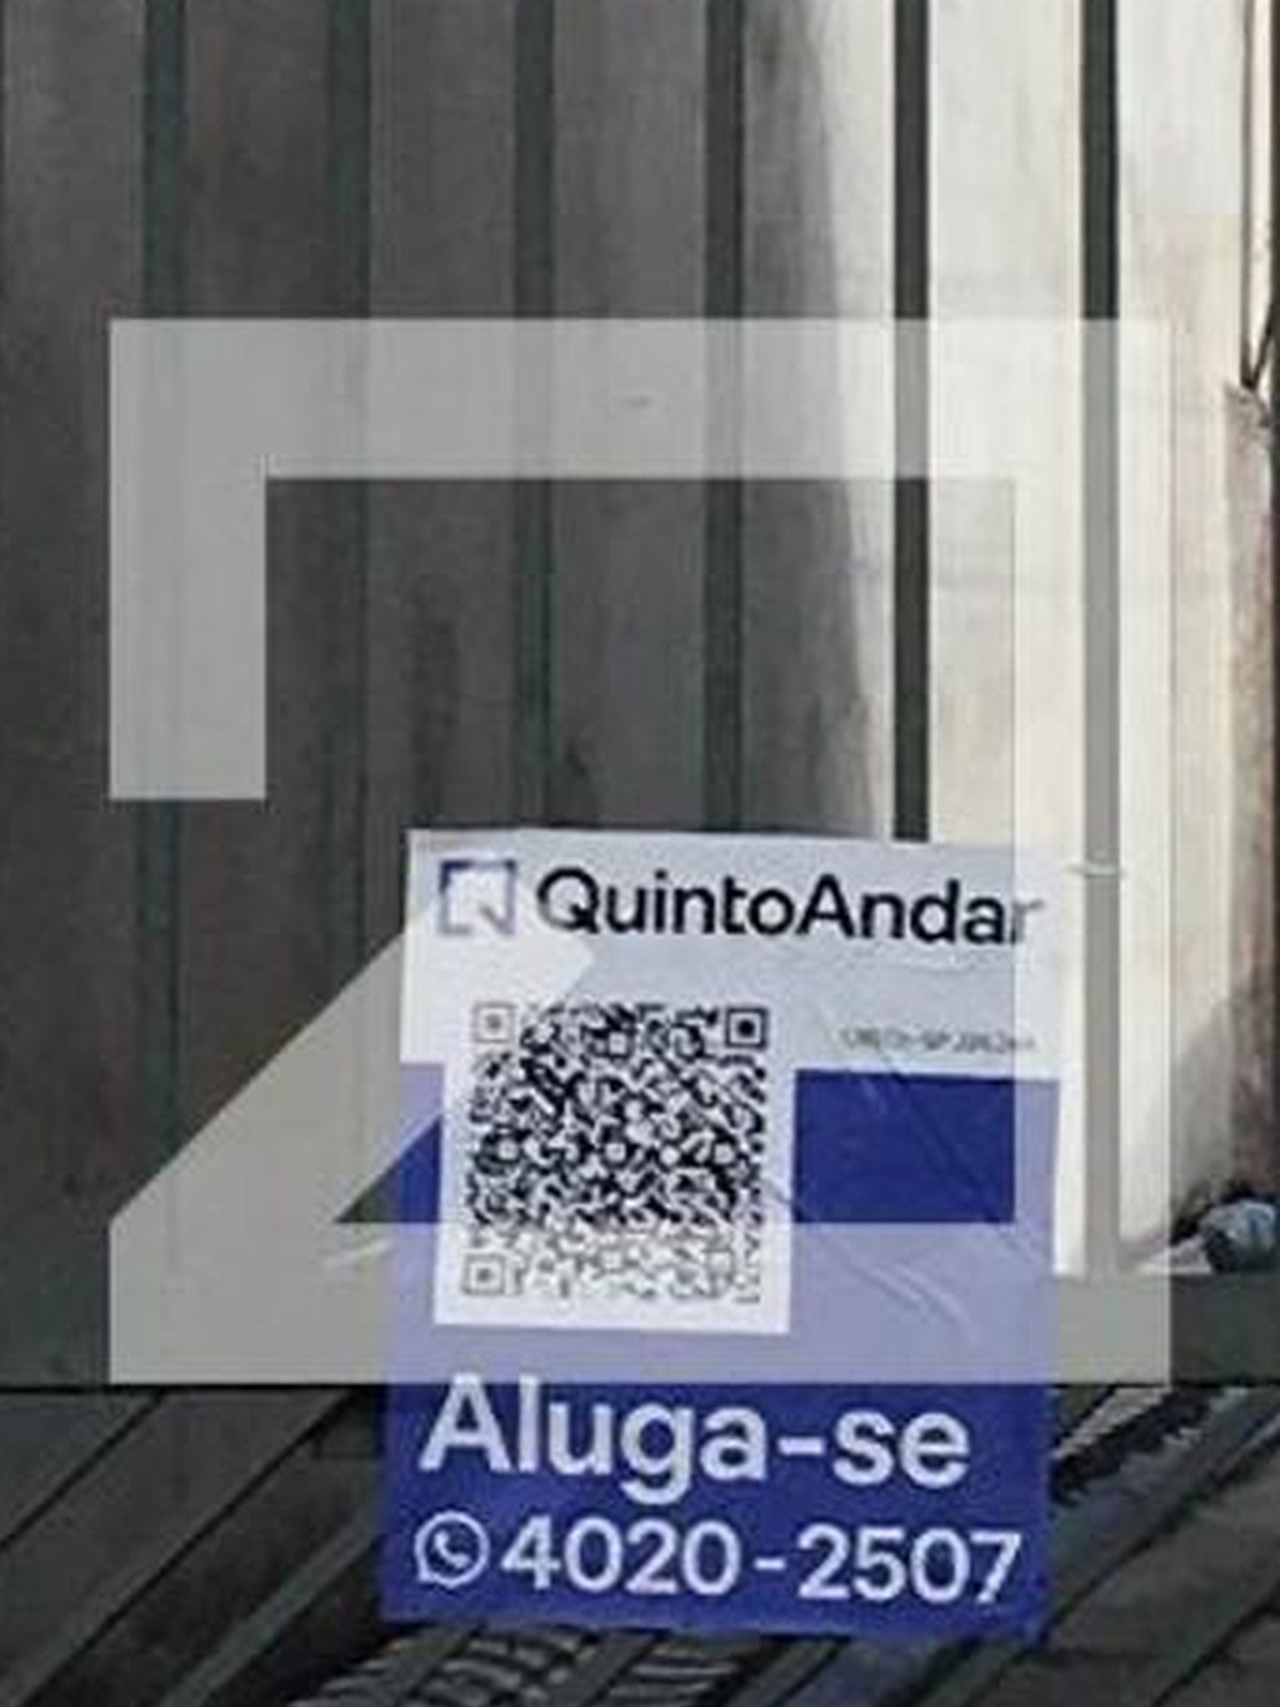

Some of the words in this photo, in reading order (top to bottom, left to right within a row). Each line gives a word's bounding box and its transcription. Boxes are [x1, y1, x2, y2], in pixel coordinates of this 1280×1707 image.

[535, 865, 1046, 946] QuintoAndar
[419, 1372, 970, 1504] Aluga-se
[502, 1515, 1022, 1605] 4020-2507
